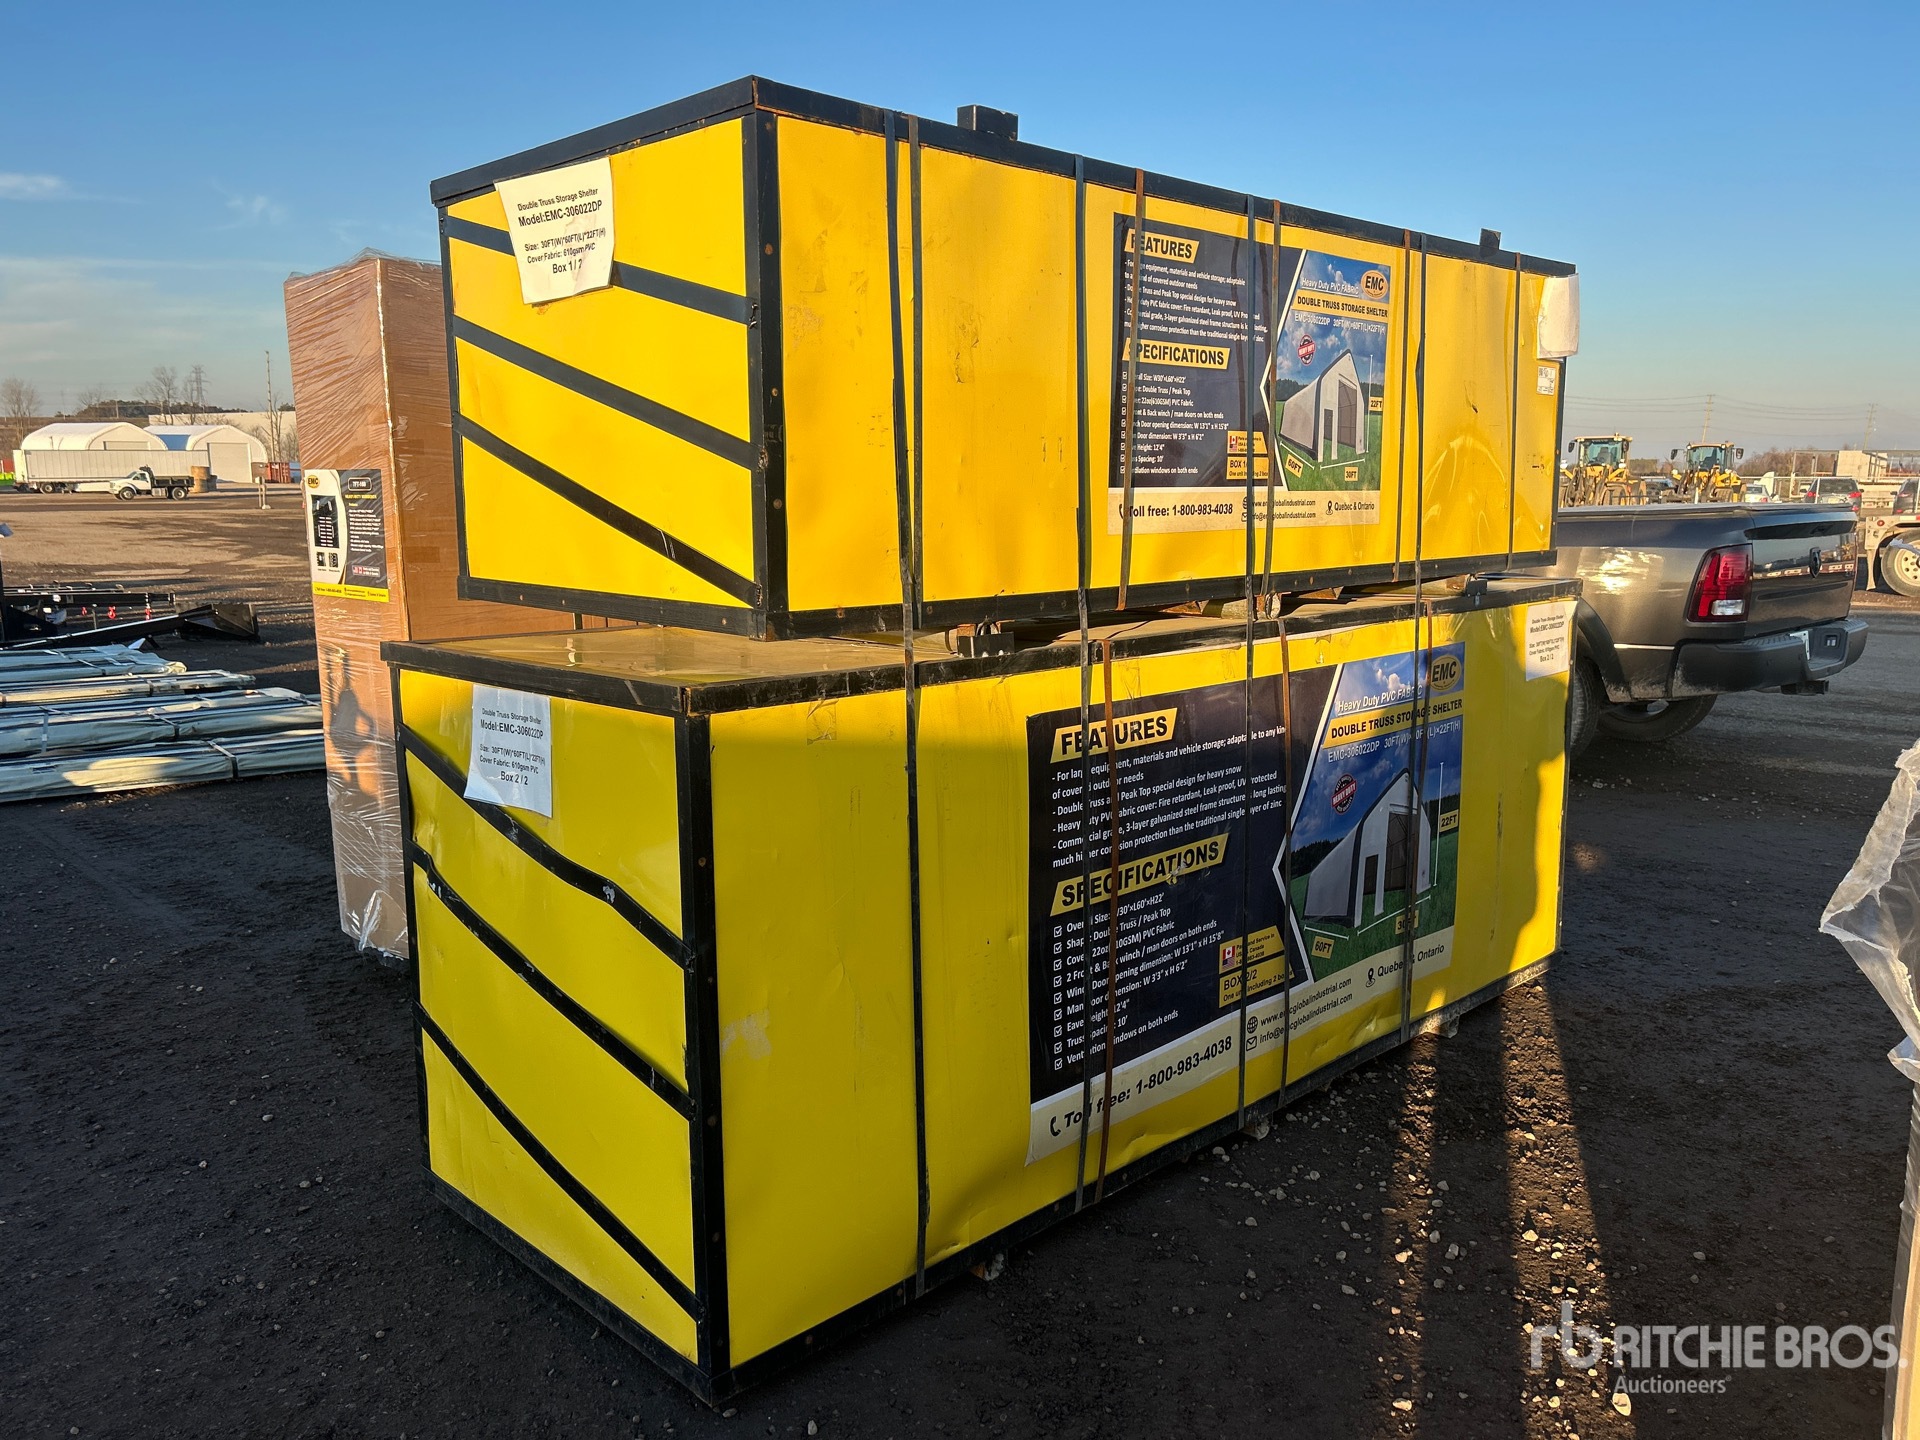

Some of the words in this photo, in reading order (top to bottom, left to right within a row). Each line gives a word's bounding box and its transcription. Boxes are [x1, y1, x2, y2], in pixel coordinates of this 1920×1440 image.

[518, 202, 539, 211] Double
[538, 198, 555, 207] Truss
[556, 194, 578, 203] Storage
[578, 189, 598, 198] Shelter
[518, 200, 602, 227] Model:EMC-306022DP
[524, 243, 539, 252] Size:
[527, 254, 543, 264] Cover
[544, 252, 562, 261] Fabric:
[585, 243, 596, 251] PVC
[552, 263, 567, 274] Box
[1302, 279, 1317, 287] Heavy
[1318, 280, 1329, 290] Duty
[1365, 276, 1384, 291] EMC
[1297, 296, 1320, 307] DOUBLE
[1322, 300, 1340, 310] TRUSS
[1341, 303, 1365, 314] STORAGE
[1366, 306, 1388, 317] SHELTER
[1230, 460, 1241, 468] BOX
[1288, 458, 1302, 473] 60FT
[1147, 505, 1169, 516] free:
[1172, 503, 1233, 516] 1-800-983-4038
[1334, 502, 1352, 511] Quebec
[1432, 661, 1457, 682] EMC
[1339, 698, 1360, 712] Heavy
[1363, 695, 1380, 707] Duty
[1381, 691, 1396, 703] PVC
[496, 710, 509, 719] Truss
[511, 713, 529, 723] Storage
[1331, 723, 1366, 738] DOUBLE
[1369, 717, 1395, 731] TRUSS
[1433, 699, 1462, 715] SHELTER
[1057, 771, 1069, 782] For
[1133, 750, 1164, 765] materials
[1165, 748, 1178, 759] and
[1179, 743, 1201, 756] vehicle
[1202, 739, 1227, 750] storage;
[1258, 730, 1265, 739] to
[1265, 728, 1276, 738] any
[1329, 740, 1380, 762] EMC-306022DP
[480, 754, 492, 764] Cover
[493, 758, 510, 768] Fabric:
[530, 765, 539, 774] PVC
[501, 770, 513, 782] Box
[1052, 790, 1061, 800] of
[1123, 771, 1144, 784] needs
[1121, 788, 1138, 801] Peak
[1139, 786, 1151, 798] Top
[1152, 780, 1175, 794] special
[1176, 776, 1196, 788] design
[1197, 773, 1206, 782] for
[1207, 769, 1224, 780] heavy
[1225, 766, 1242, 775] snow
[1058, 821, 1081, 833] Heavy
[1137, 802, 1158, 814] cover:
[1158, 798, 1171, 808] Fire
[1172, 790, 1202, 805] retardant,
[1203, 784, 1220, 796] Leak
[1218, 781, 1236, 794] proof,
[1237, 778, 1247, 787] UV
[1126, 819, 1149, 833] 3-layer
[1150, 810, 1183, 826] galvanized
[1184, 804, 1198, 816] steel
[1200, 801, 1217, 811] frame
[1218, 794, 1246, 807] structure
[1253, 790, 1266, 800] long
[1441, 815, 1457, 827] 22FT
[1053, 855, 1073, 868] much
[1134, 831, 1167, 848] protection
[1169, 825, 1183, 836] than
[1184, 820, 1194, 830] the
[1196, 812, 1226, 827] traditional
[1228, 808, 1245, 819] single
[1262, 801, 1269, 810] of
[1270, 800, 1282, 809] zinc
[1094, 913, 1110, 924] Size:
[1120, 919, 1137, 931] Truss
[1143, 912, 1158, 924] Peak
[1160, 908, 1171, 918] Top
[1143, 927, 1155, 939] PVC
[1156, 920, 1175, 934] Fabric
[1066, 973, 1071, 982] 2
[1120, 949, 1140, 963] winch
[1146, 944, 1160, 954] man
[1161, 935, 1178, 948] doors
[1179, 932, 1187, 940] on
[1188, 925, 1202, 937] both
[1203, 920, 1217, 933] ends
[1314, 941, 1332, 953] 60FT
[1417, 944, 1444, 961] Ontario
[1092, 977, 1109, 990] Door
[1139, 954, 1173, 972] dimension:
[1174, 948, 1181, 957] W
[1067, 1003, 1084, 1015] Man
[1143, 975, 1151, 985] W
[1224, 993, 1234, 1002] One
[1273, 976, 1277, 984] 2
[1067, 1019, 1084, 1031] Eave
[1117, 1015, 1128, 1027] 10'
[1138, 1026, 1147, 1034] on
[1148, 1018, 1162, 1030] both
[1164, 1010, 1178, 1022] ends
[1136, 1036, 1232, 1094] 1-800-983-4038
